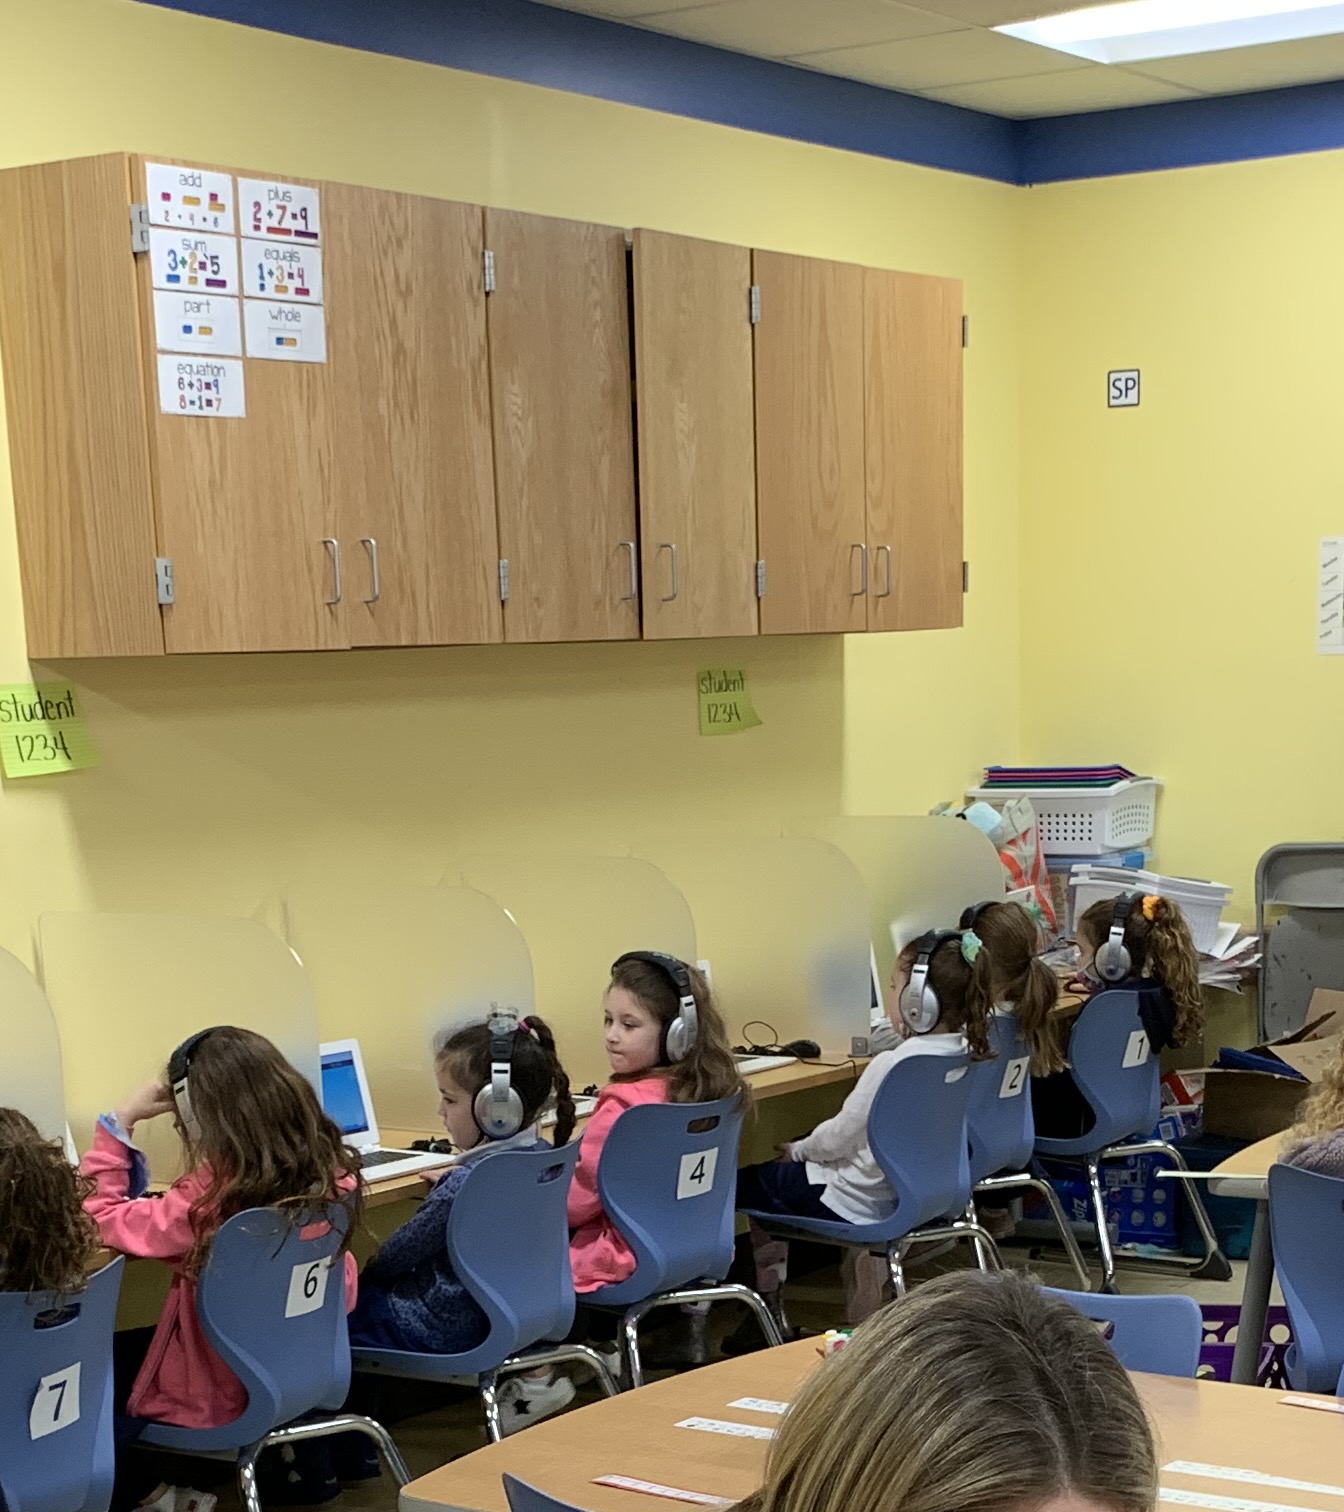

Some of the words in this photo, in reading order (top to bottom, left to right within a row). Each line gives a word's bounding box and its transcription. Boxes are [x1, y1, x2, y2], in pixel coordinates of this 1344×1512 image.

[179, 173, 202, 188] add
[267, 187, 292, 202] plus
[182, 238, 206, 251] sum
[264, 249, 301, 263] equals
[183, 300, 211, 314] part
[269, 308, 301, 322] whole
[177, 363, 226, 378] equation
[1111, 377, 1136, 401] SP
[700, 670, 744, 694] student
[708, 702, 740, 723] 1234
[14, 731, 72, 763] 1234
[1135, 1037, 1145, 1059] 1
[1008, 1064, 1022, 1090] 2
[689, 1156, 706, 1185] 4
[303, 1263, 319, 1298] 6
[49, 1380, 67, 1421] 7
